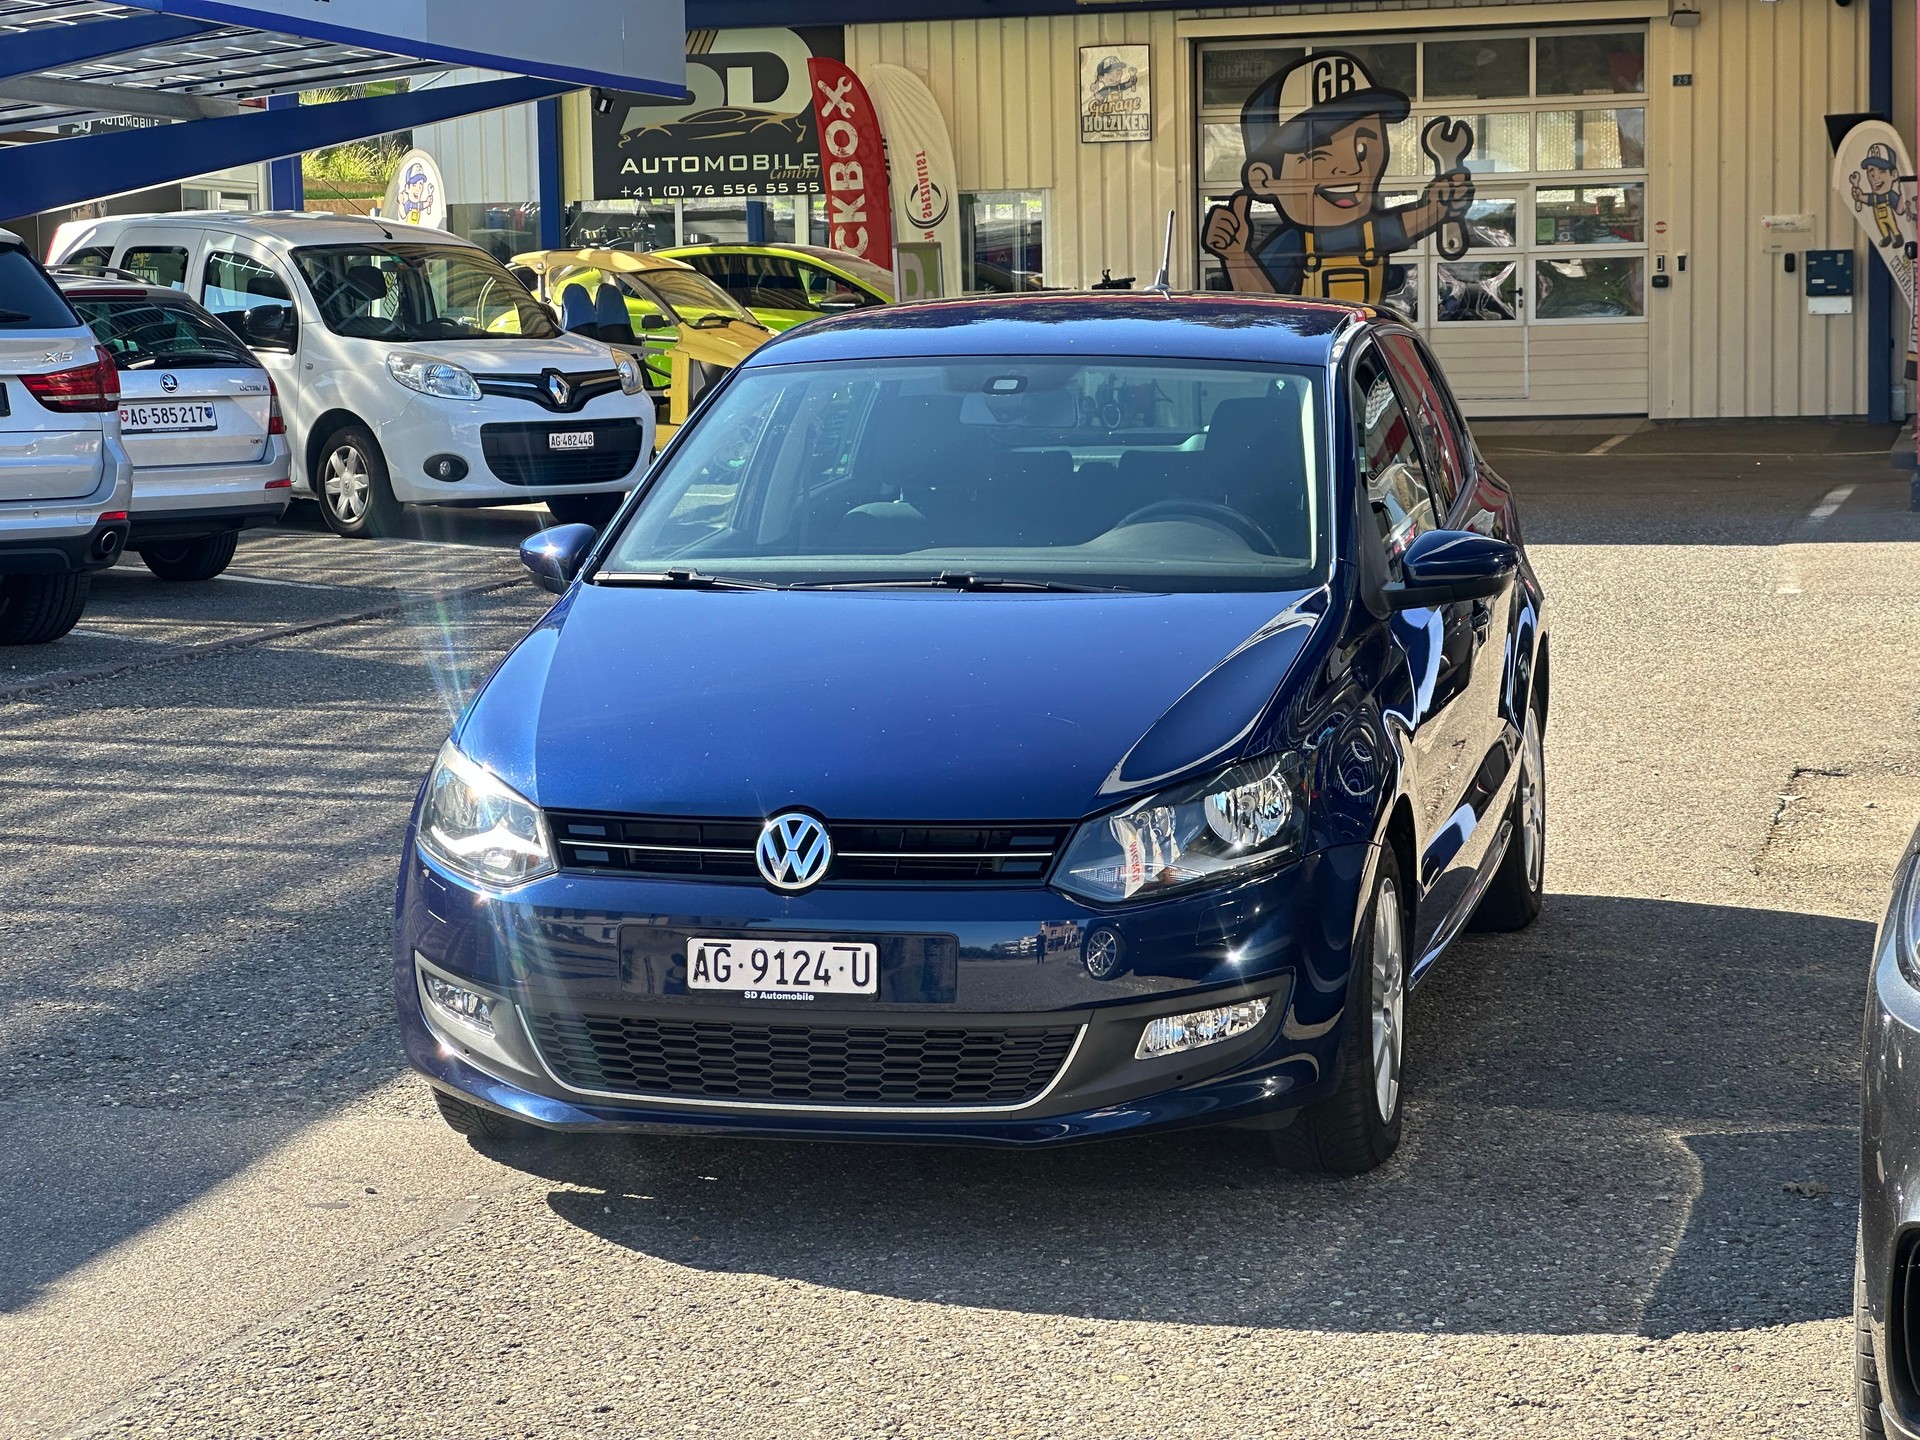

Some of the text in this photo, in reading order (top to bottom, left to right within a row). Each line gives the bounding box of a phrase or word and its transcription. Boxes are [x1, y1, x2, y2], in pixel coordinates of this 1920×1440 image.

[1313, 58, 1356, 104] GB
[1088, 97, 1141, 115] Garage
[1082, 113, 1149, 132] HOLZIKEN
[620, 152, 819, 175] AUTOMOBILE
[769, 163, 820, 180] GmbH
[816, 76, 869, 257] CKBOX
[620, 181, 820, 197] +41 (0) 76 556 55 55
[41, 350, 75, 363] X5
[743, 990, 815, 1001] SD Automobile
